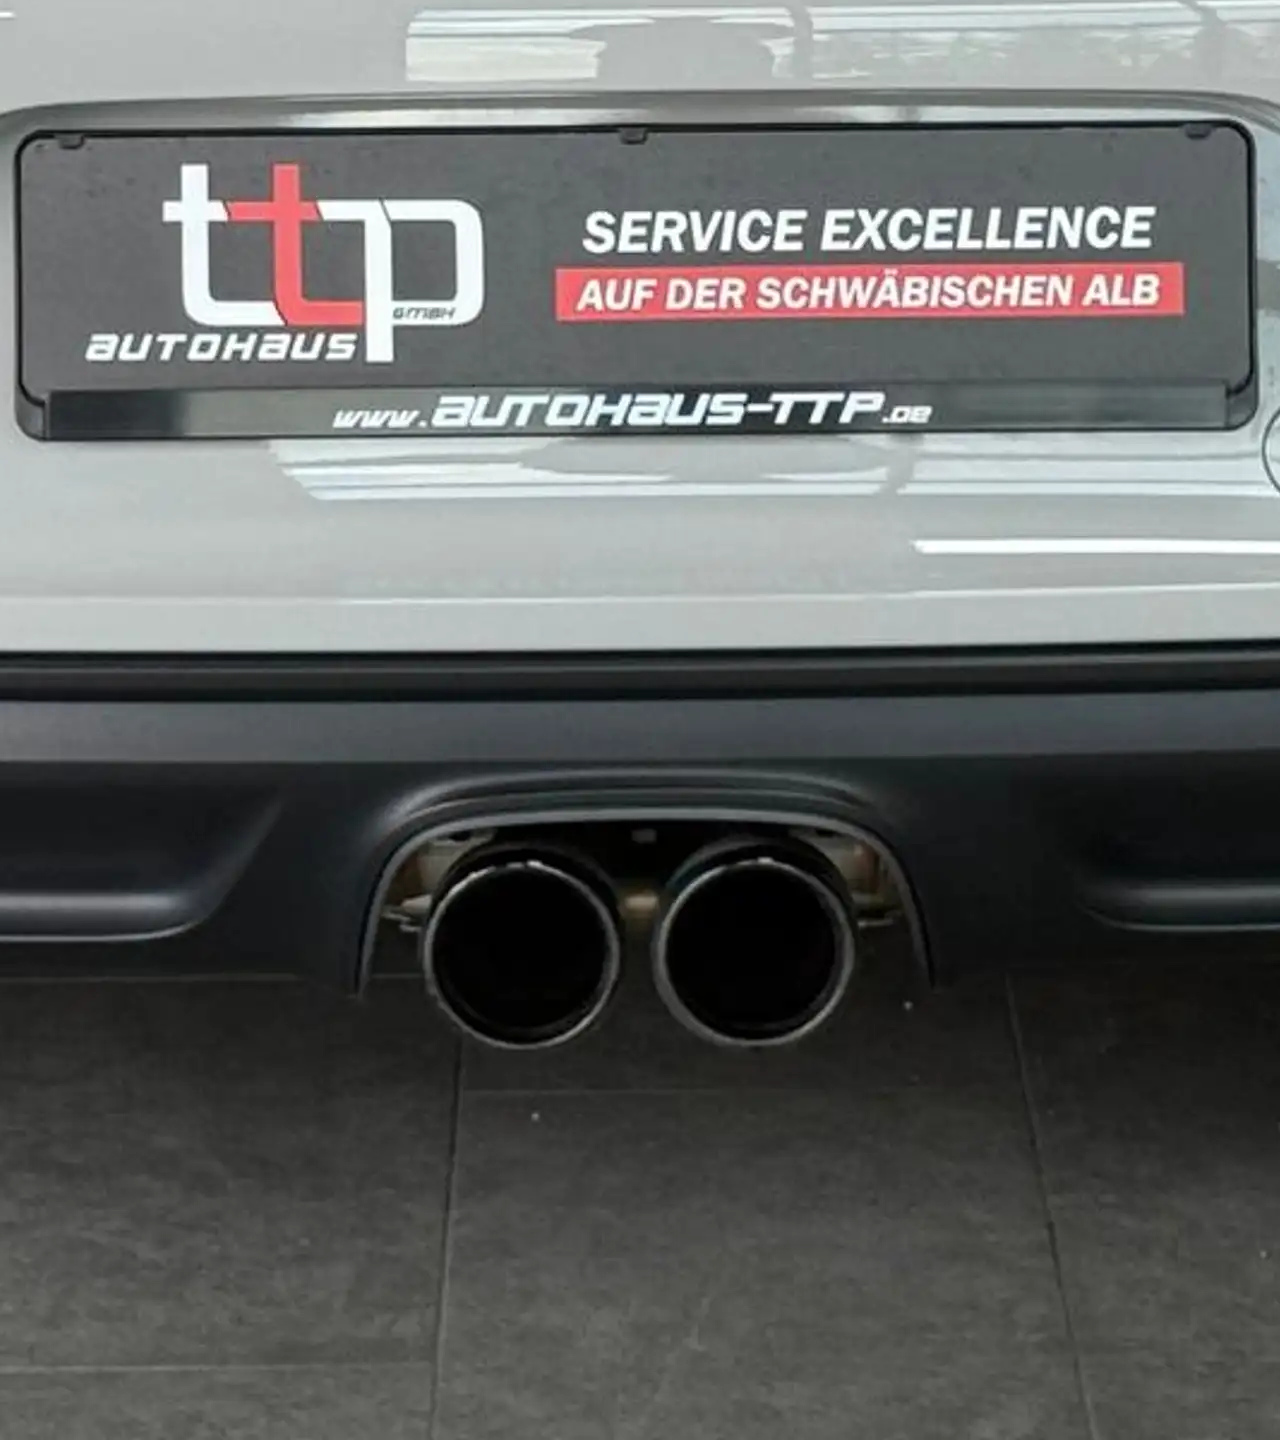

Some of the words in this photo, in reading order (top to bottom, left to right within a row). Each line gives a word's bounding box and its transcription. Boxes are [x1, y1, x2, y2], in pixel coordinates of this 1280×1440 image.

[582, 209, 808, 254] SERVICE
[820, 206, 1158, 252] EXCELLENCE
[162, 163, 486, 363] ttp
[576, 278, 656, 311] AUF
[665, 277, 746, 311] DER
[755, 269, 1075, 310] SCHWÄBISCHEN
[1083, 273, 1161, 307] ALB
